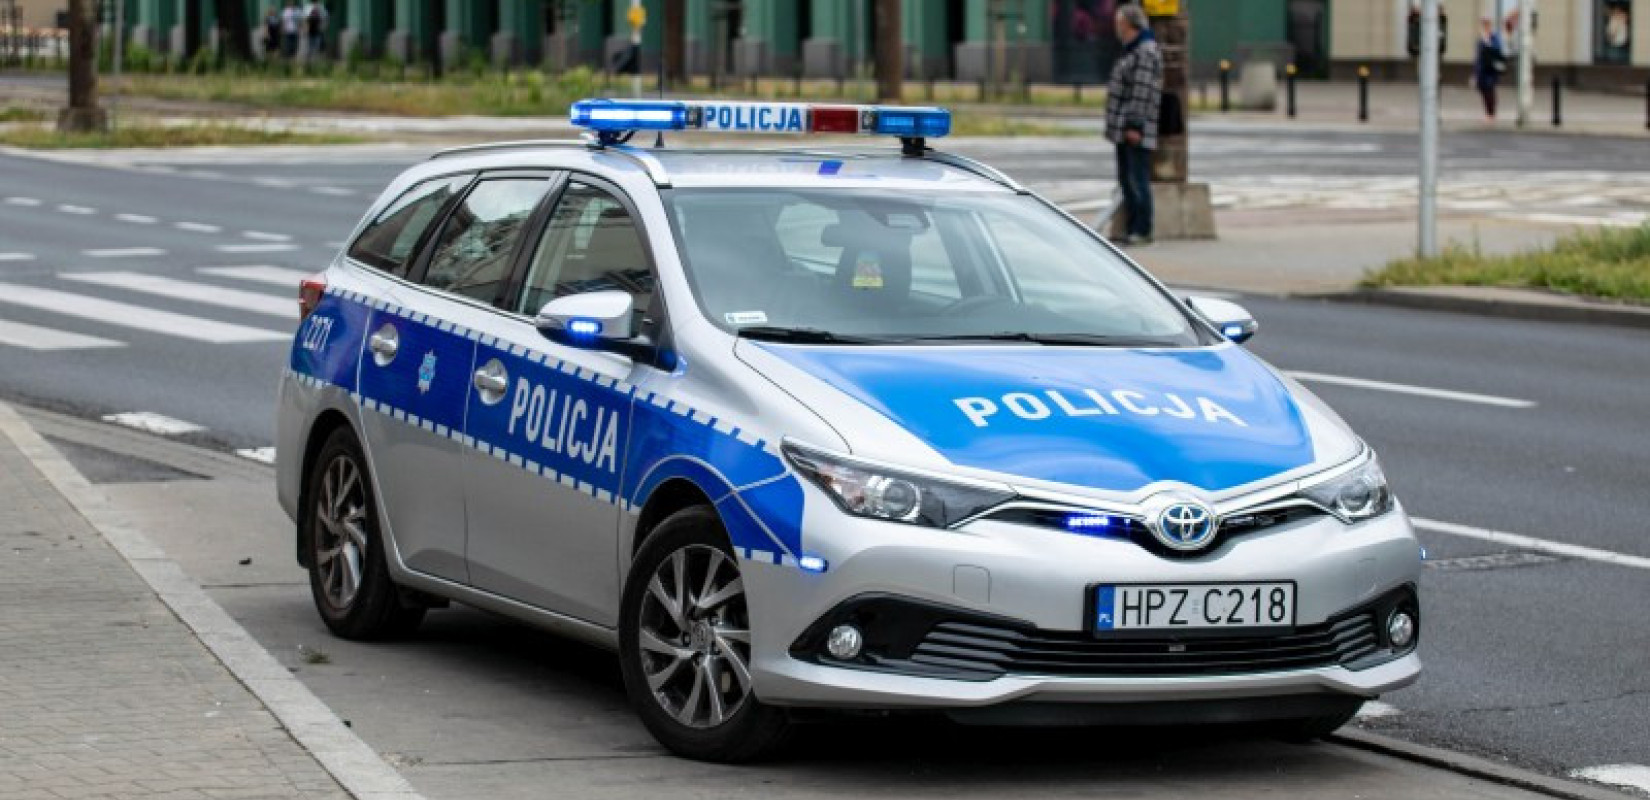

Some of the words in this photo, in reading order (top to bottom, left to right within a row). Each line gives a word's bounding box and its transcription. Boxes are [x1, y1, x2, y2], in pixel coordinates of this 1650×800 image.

[705, 106, 802, 131] POLICJA
[508, 376, 618, 473] POLICJA
[952, 388, 1248, 427] POLICJA
[1121, 588, 1188, 626] HPZ
[1203, 587, 1286, 624] C218
